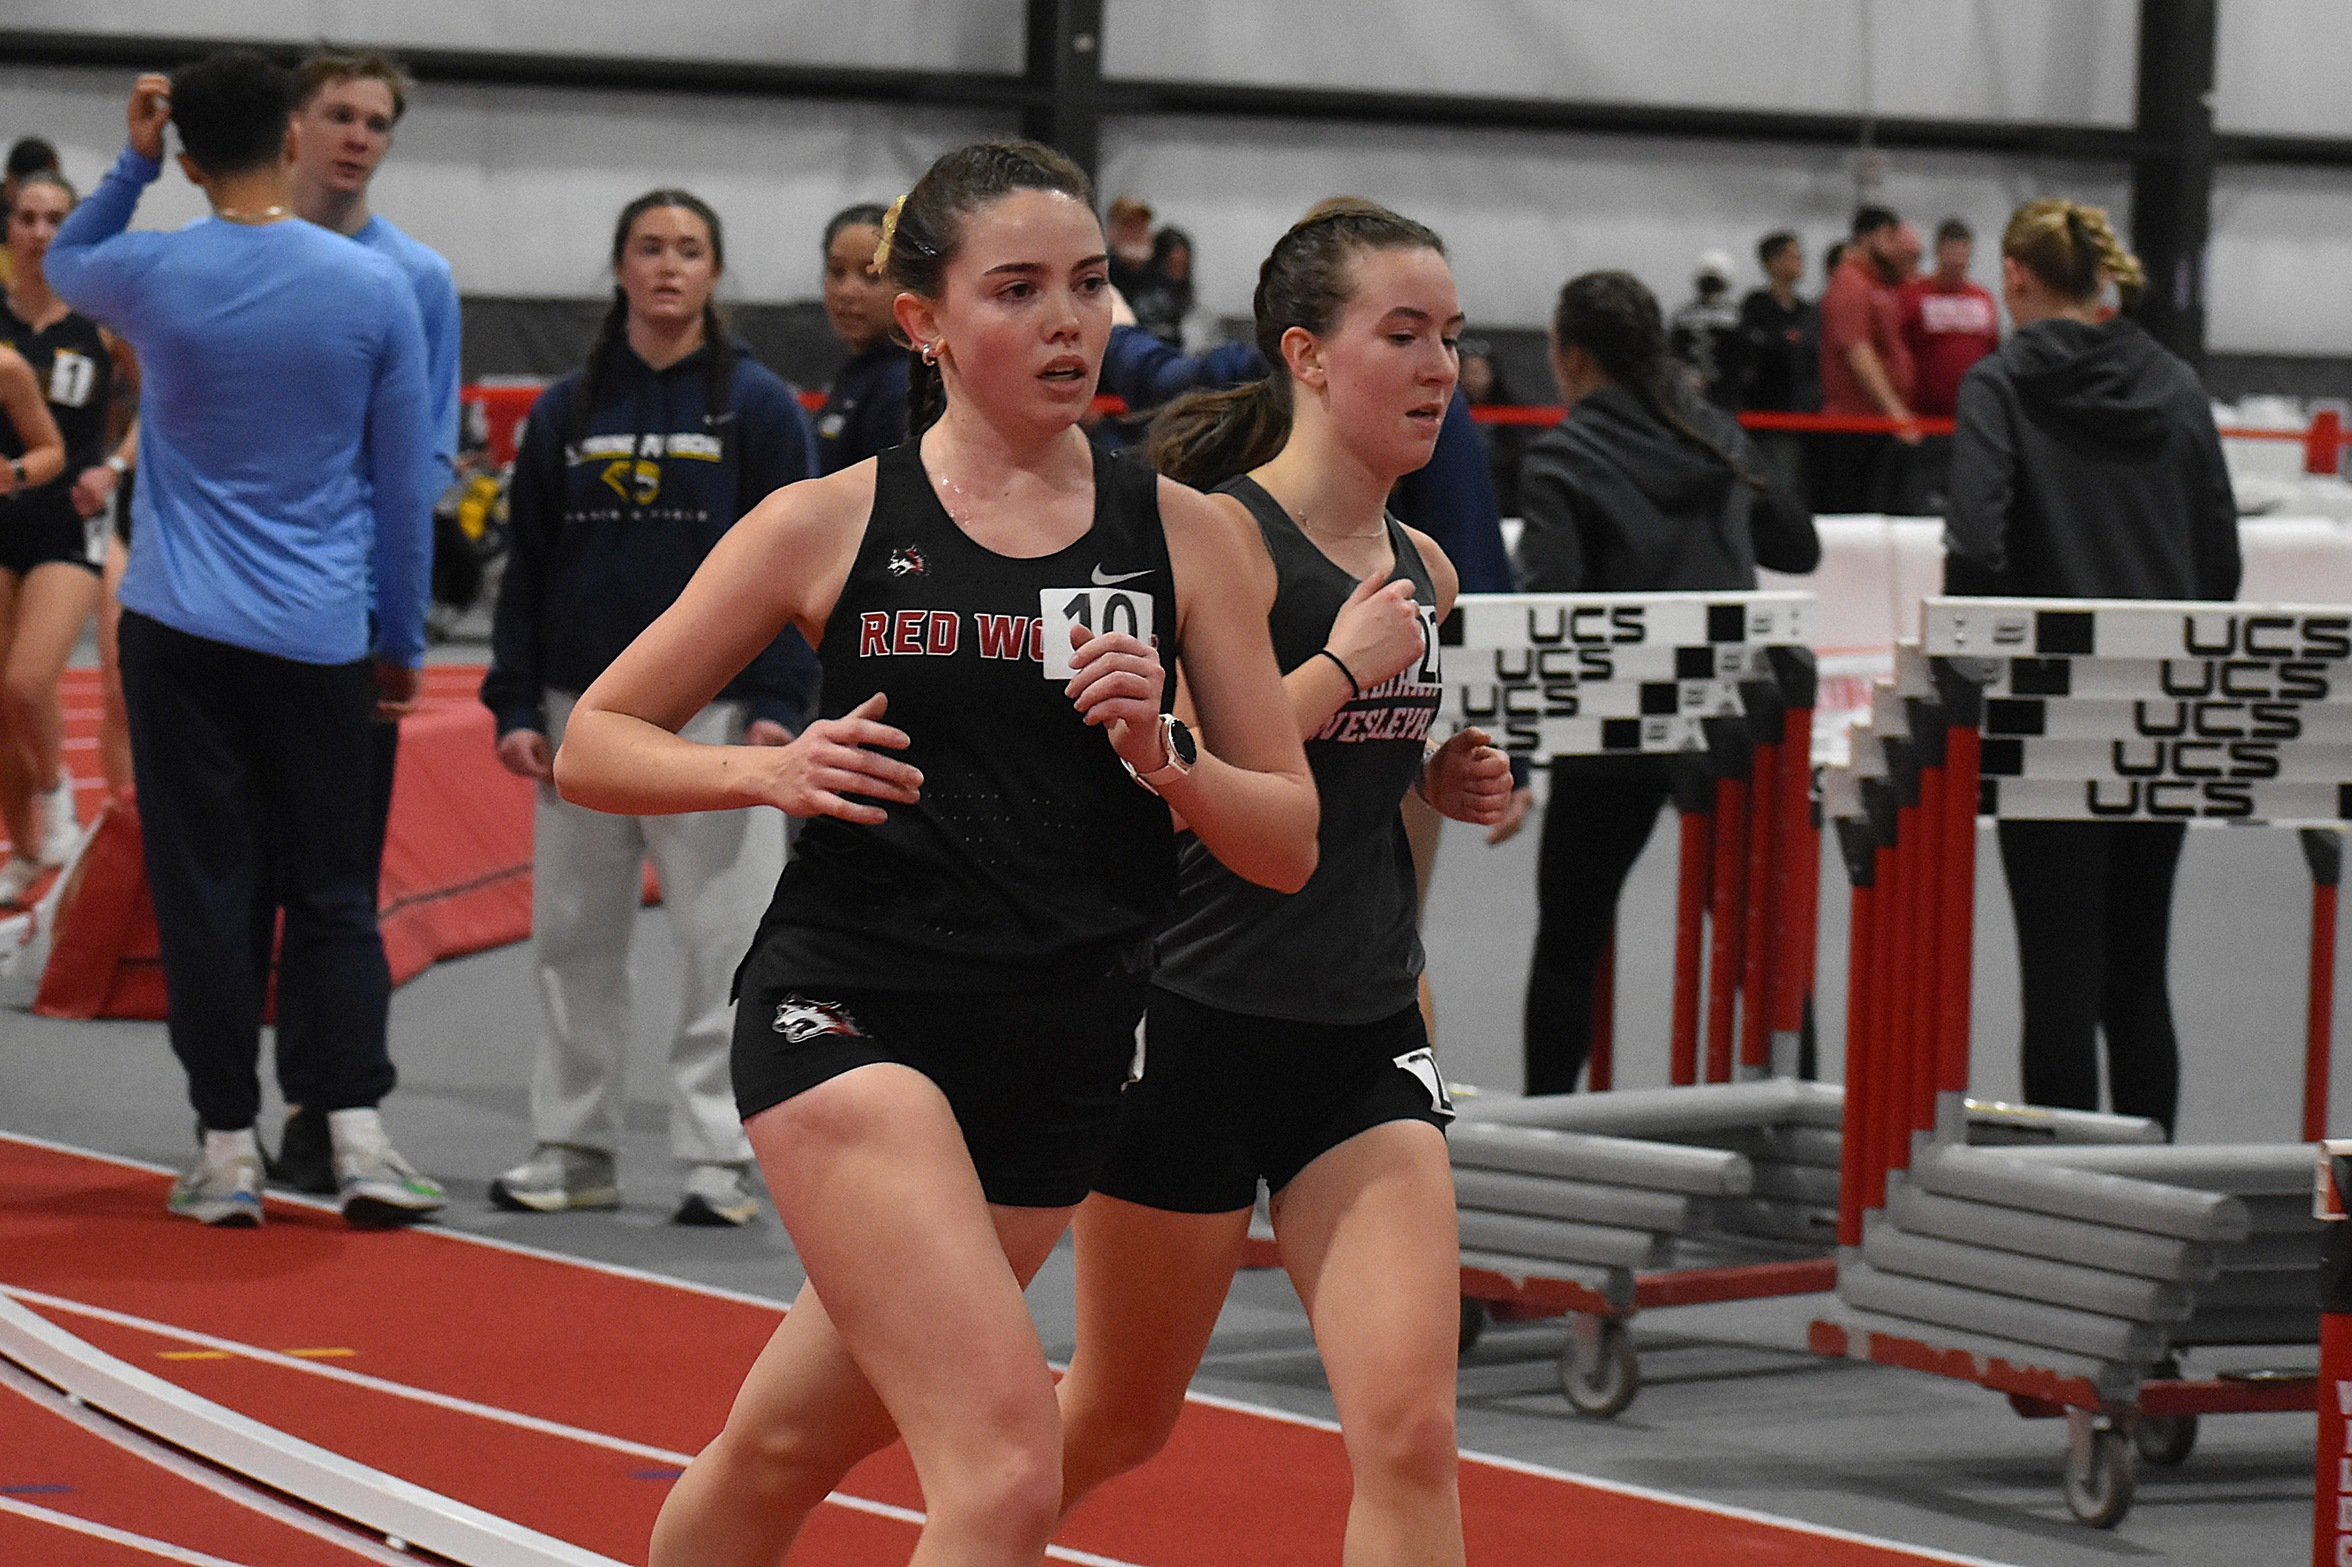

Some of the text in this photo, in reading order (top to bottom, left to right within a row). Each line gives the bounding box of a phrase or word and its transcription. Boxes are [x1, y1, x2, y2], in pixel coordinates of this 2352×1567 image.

[860, 610, 960, 657] RED
[1062, 592, 1139, 638] 10
[1528, 606, 1645, 644] UCS
[2183, 615, 2351, 657] UCS
[1495, 648, 1613, 681] UCS
[2159, 658, 2329, 698] UCS
[1461, 683, 1578, 717] UCS
[2134, 700, 2301, 738] UCS
[1313, 706, 1435, 742] WESLEYA
[2111, 740, 2280, 778] UCS
[2086, 780, 2254, 817] UCS
